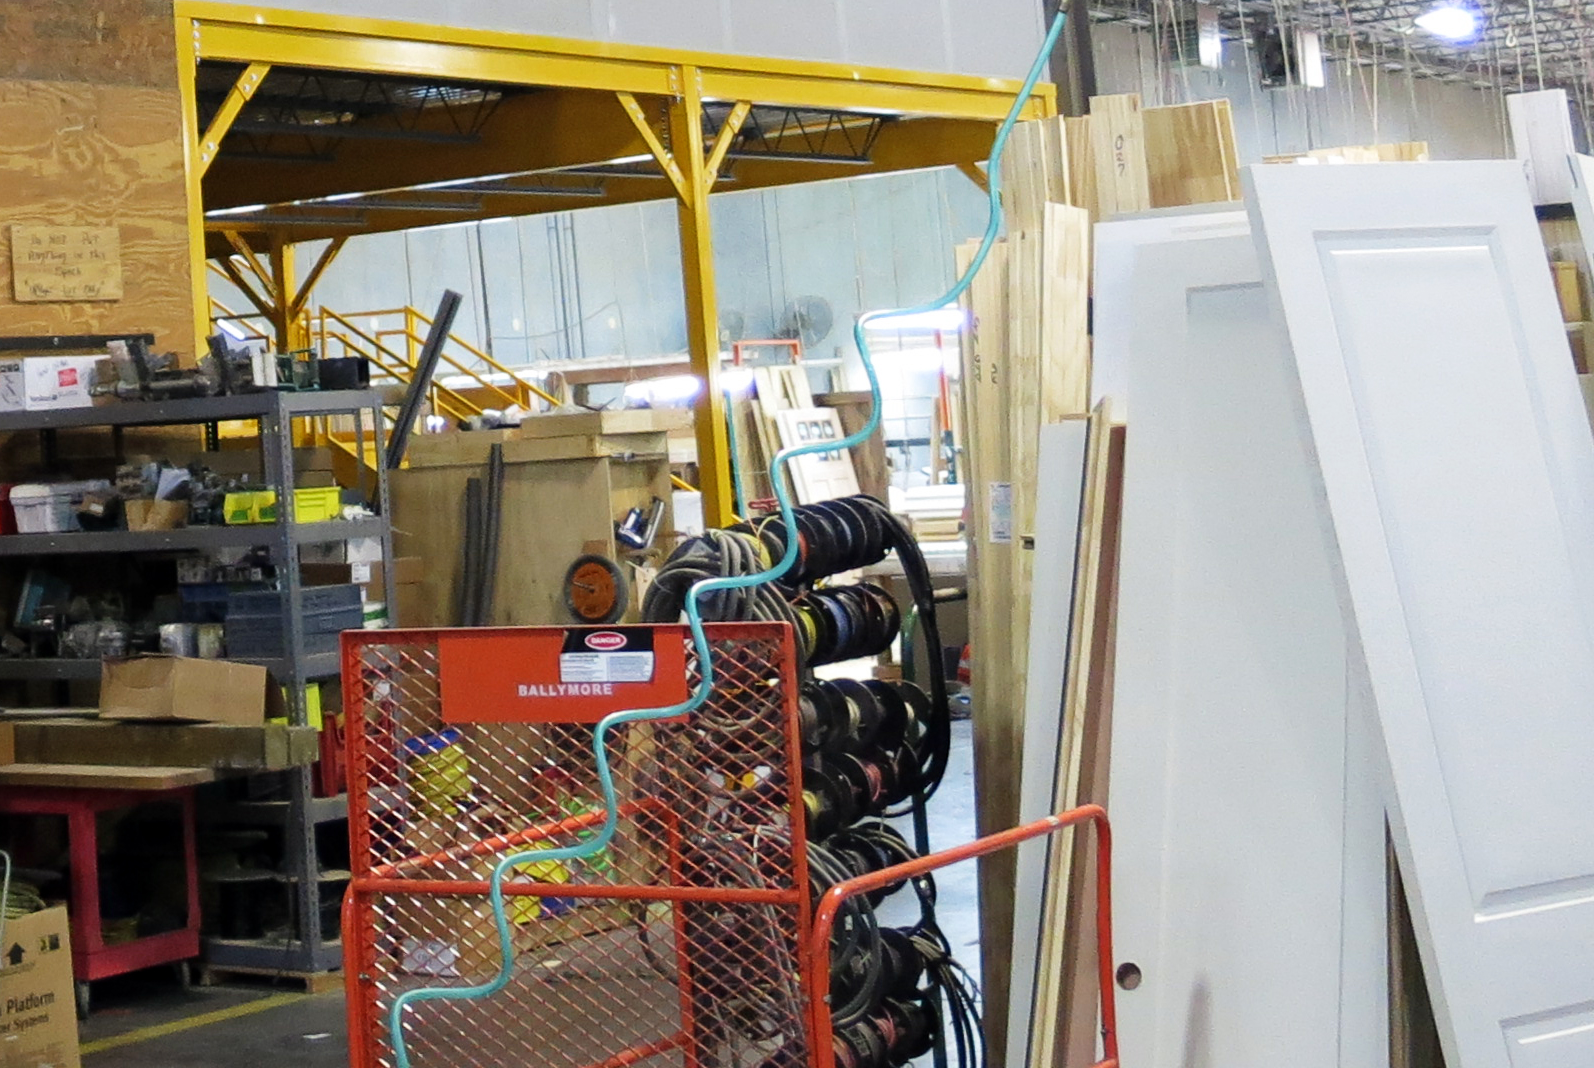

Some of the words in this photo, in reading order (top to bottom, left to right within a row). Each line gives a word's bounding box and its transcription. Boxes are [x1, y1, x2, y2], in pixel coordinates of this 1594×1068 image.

[590, 636, 622, 645] DANGER
[517, 683, 613, 697] BALLYMORE
[6, 991, 56, 1015] Platform
